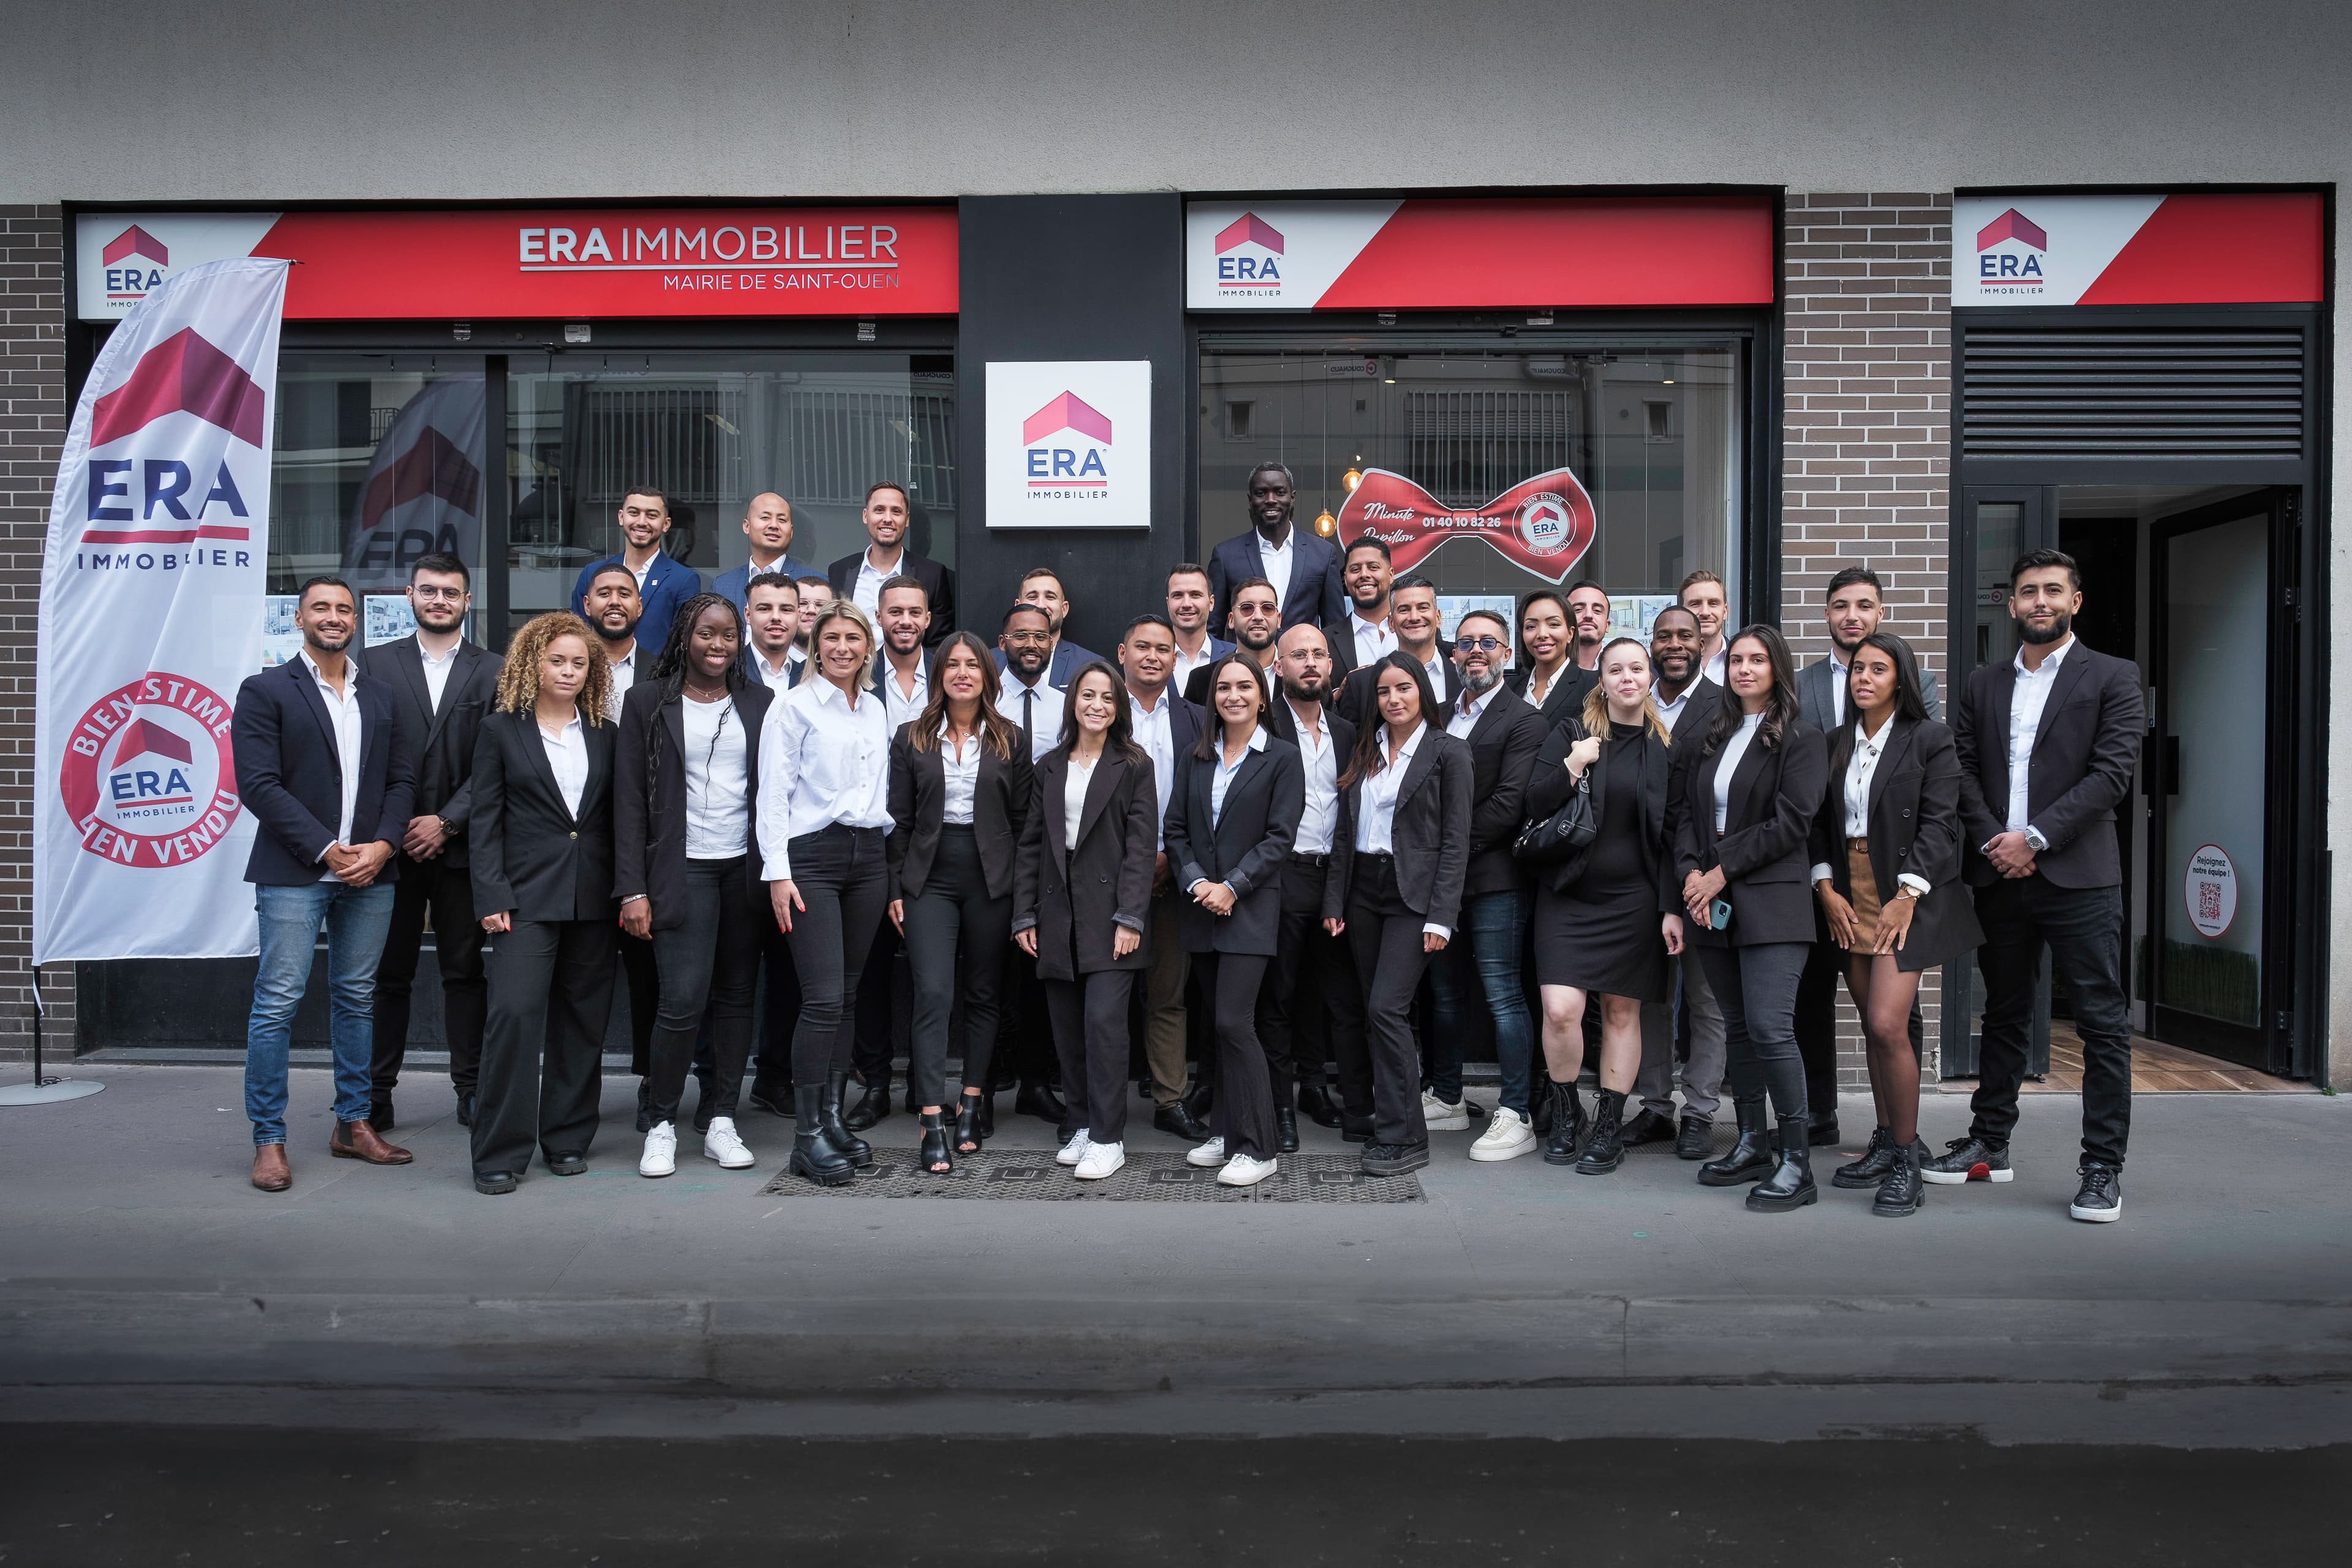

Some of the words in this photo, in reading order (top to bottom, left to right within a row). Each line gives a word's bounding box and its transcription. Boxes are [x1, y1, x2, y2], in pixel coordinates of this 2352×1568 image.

[520, 227, 613, 262] ERA
[622, 225, 897, 261] IMMOBILIER
[1218, 257, 1280, 279] ERA
[1980, 254, 2043, 277] ERA
[107, 269, 162, 291] ERA
[664, 274, 733, 290] MAIRIE
[739, 274, 766, 290] DE
[774, 273, 899, 289] SAINT-OUEN
[1028, 448, 1107, 477] ERA
[87, 458, 249, 521] ERA
[1523, 496, 1537, 508] BIEN
[1540, 494, 1564, 505] ESTIME
[1363, 502, 1415, 521] Minute
[1422, 517, 1434, 527] 01
[1437, 517, 1452, 527] 40
[1455, 517, 1468, 527] 10
[1471, 517, 1485, 527] 82
[1487, 517, 1501, 527] 26
[1533, 522, 1558, 534] ERA
[1528, 545, 1543, 555] BIEN
[1547, 539, 1569, 555] VENDU
[72, 693, 136, 757] BIEN
[110, 768, 192, 800] ERA
[117, 805, 195, 820] IMMOBILIER
[149, 789, 239, 864] VENDU
[2196, 856, 2226, 867] Rejoignez
[2207, 867, 2226, 877] équipe
